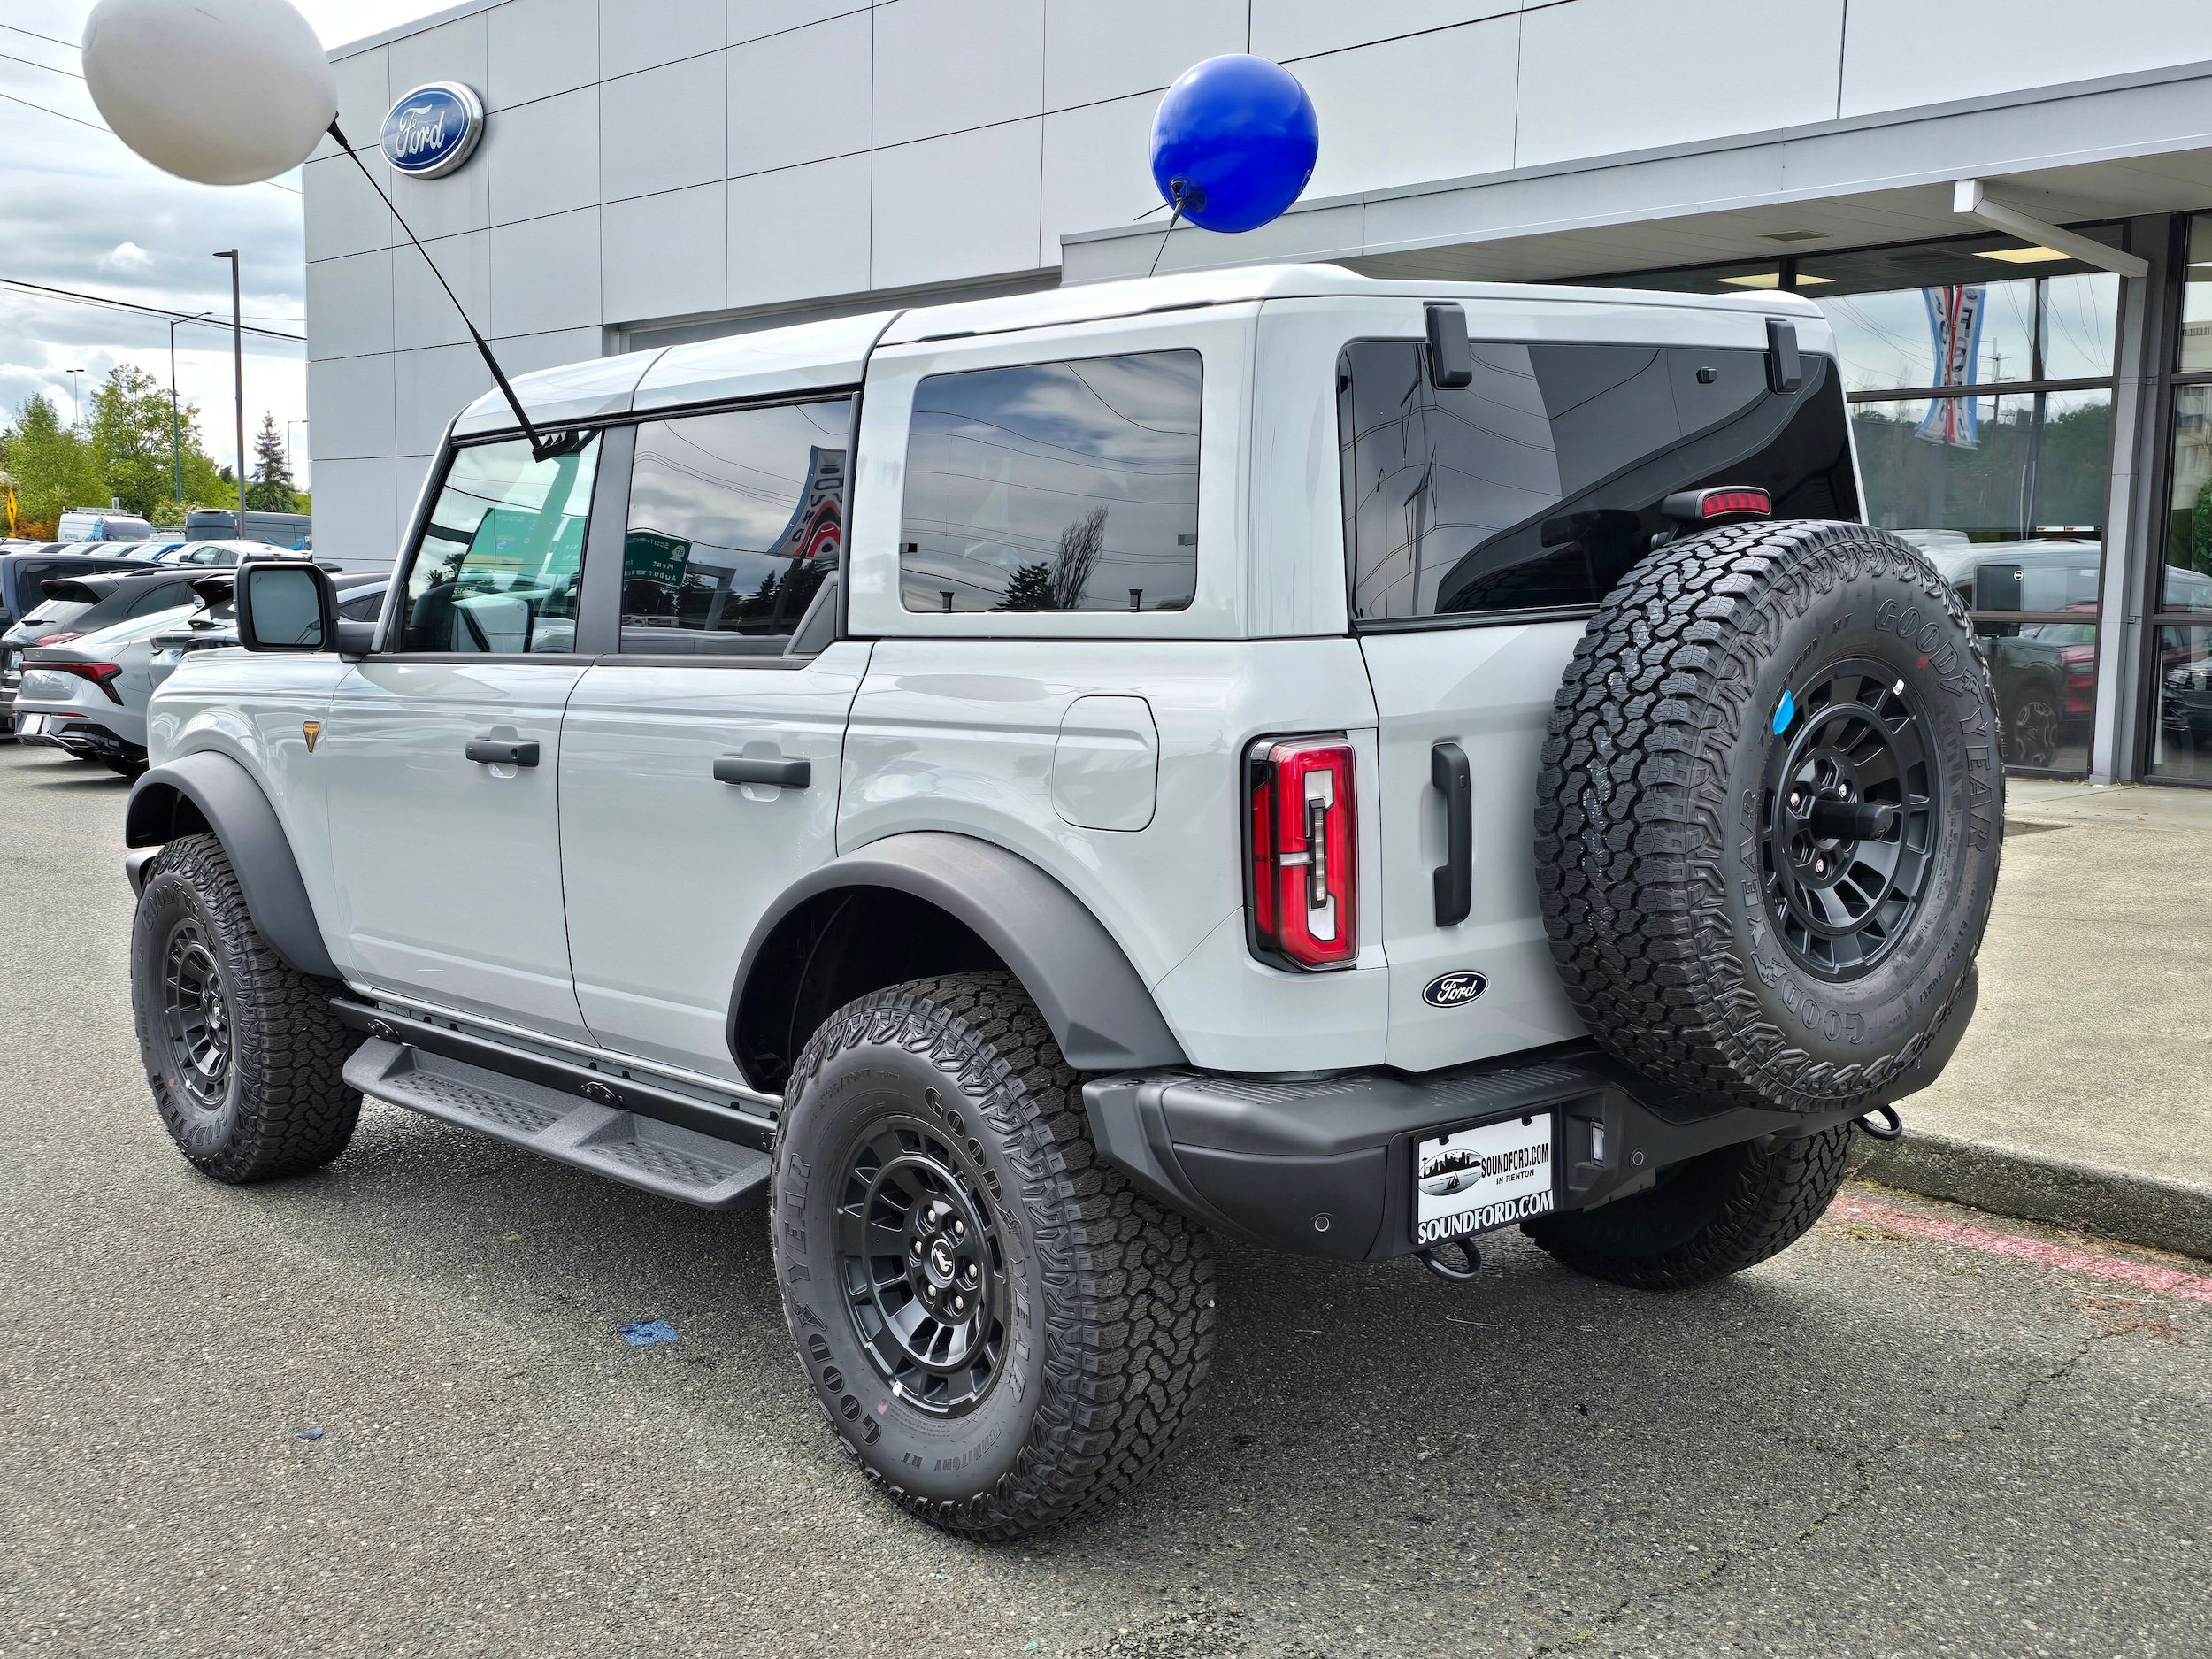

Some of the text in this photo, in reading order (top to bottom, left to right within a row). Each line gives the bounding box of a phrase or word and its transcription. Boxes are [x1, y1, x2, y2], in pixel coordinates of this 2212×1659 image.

[396, 104, 446, 158] Ford
[1437, 977, 1478, 1002] Ford
[1480, 1142, 1549, 1179] SOUNDFORD.COM
[1495, 1168, 1535, 1186] IN RENTON
[1417, 1189, 1555, 1245] SOUNDFORD.COM
